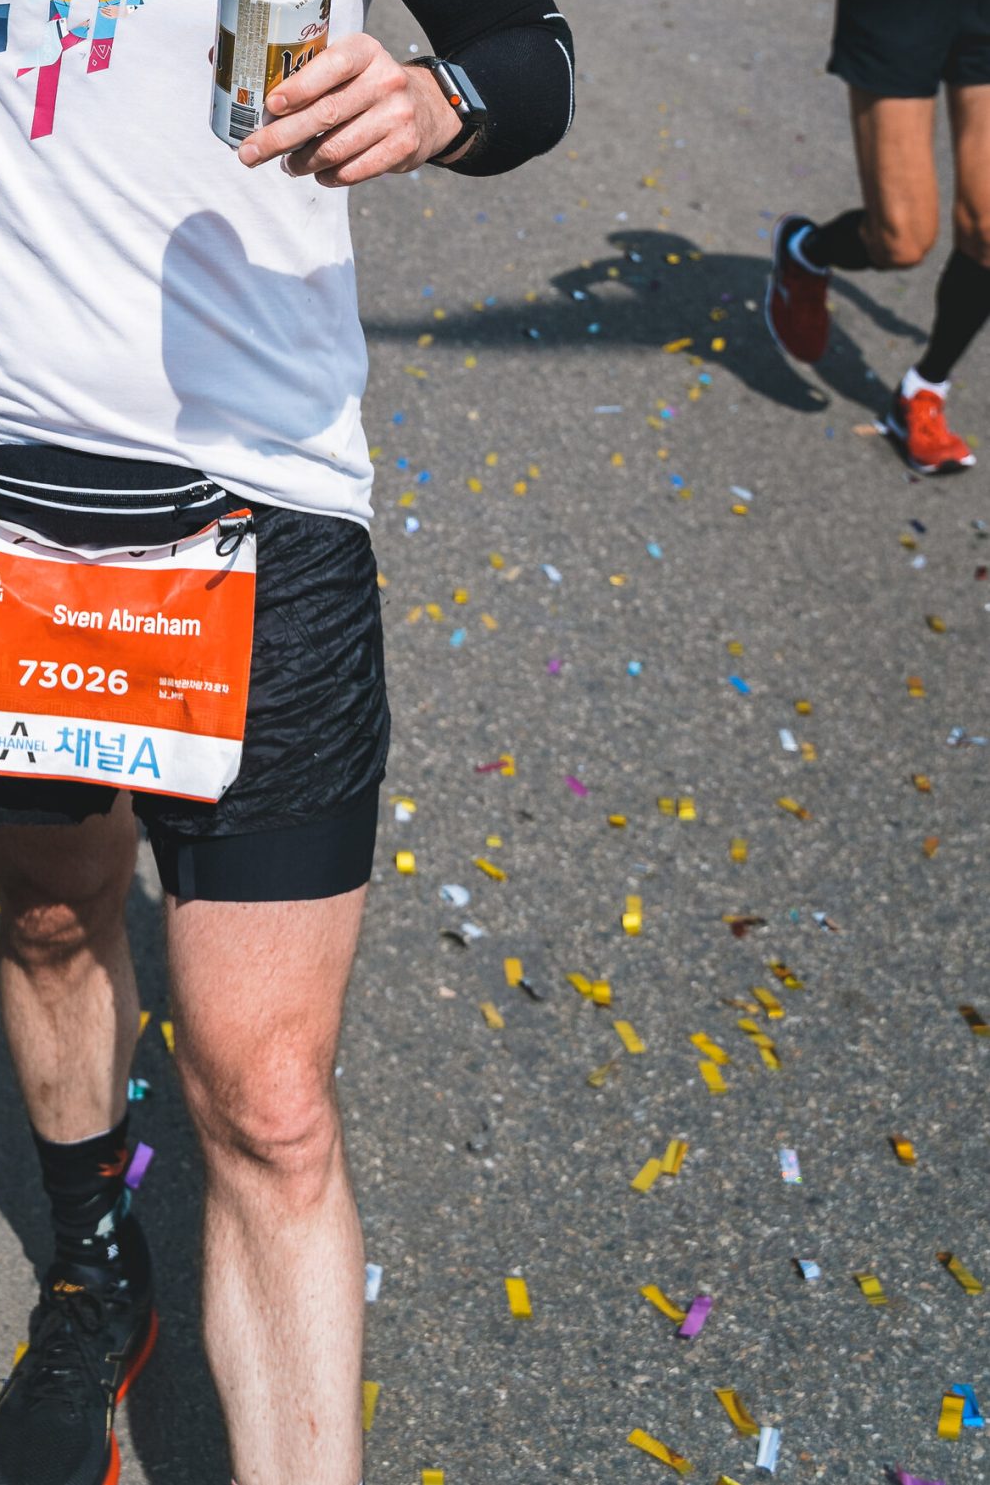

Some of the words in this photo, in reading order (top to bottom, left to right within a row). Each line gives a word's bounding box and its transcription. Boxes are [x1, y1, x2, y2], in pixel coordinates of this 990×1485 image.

[53, 604, 103, 630] Sven
[107, 608, 201, 637] Abraham
[18, 659, 129, 695] 73026
[54, 726, 161, 779] 채널A
